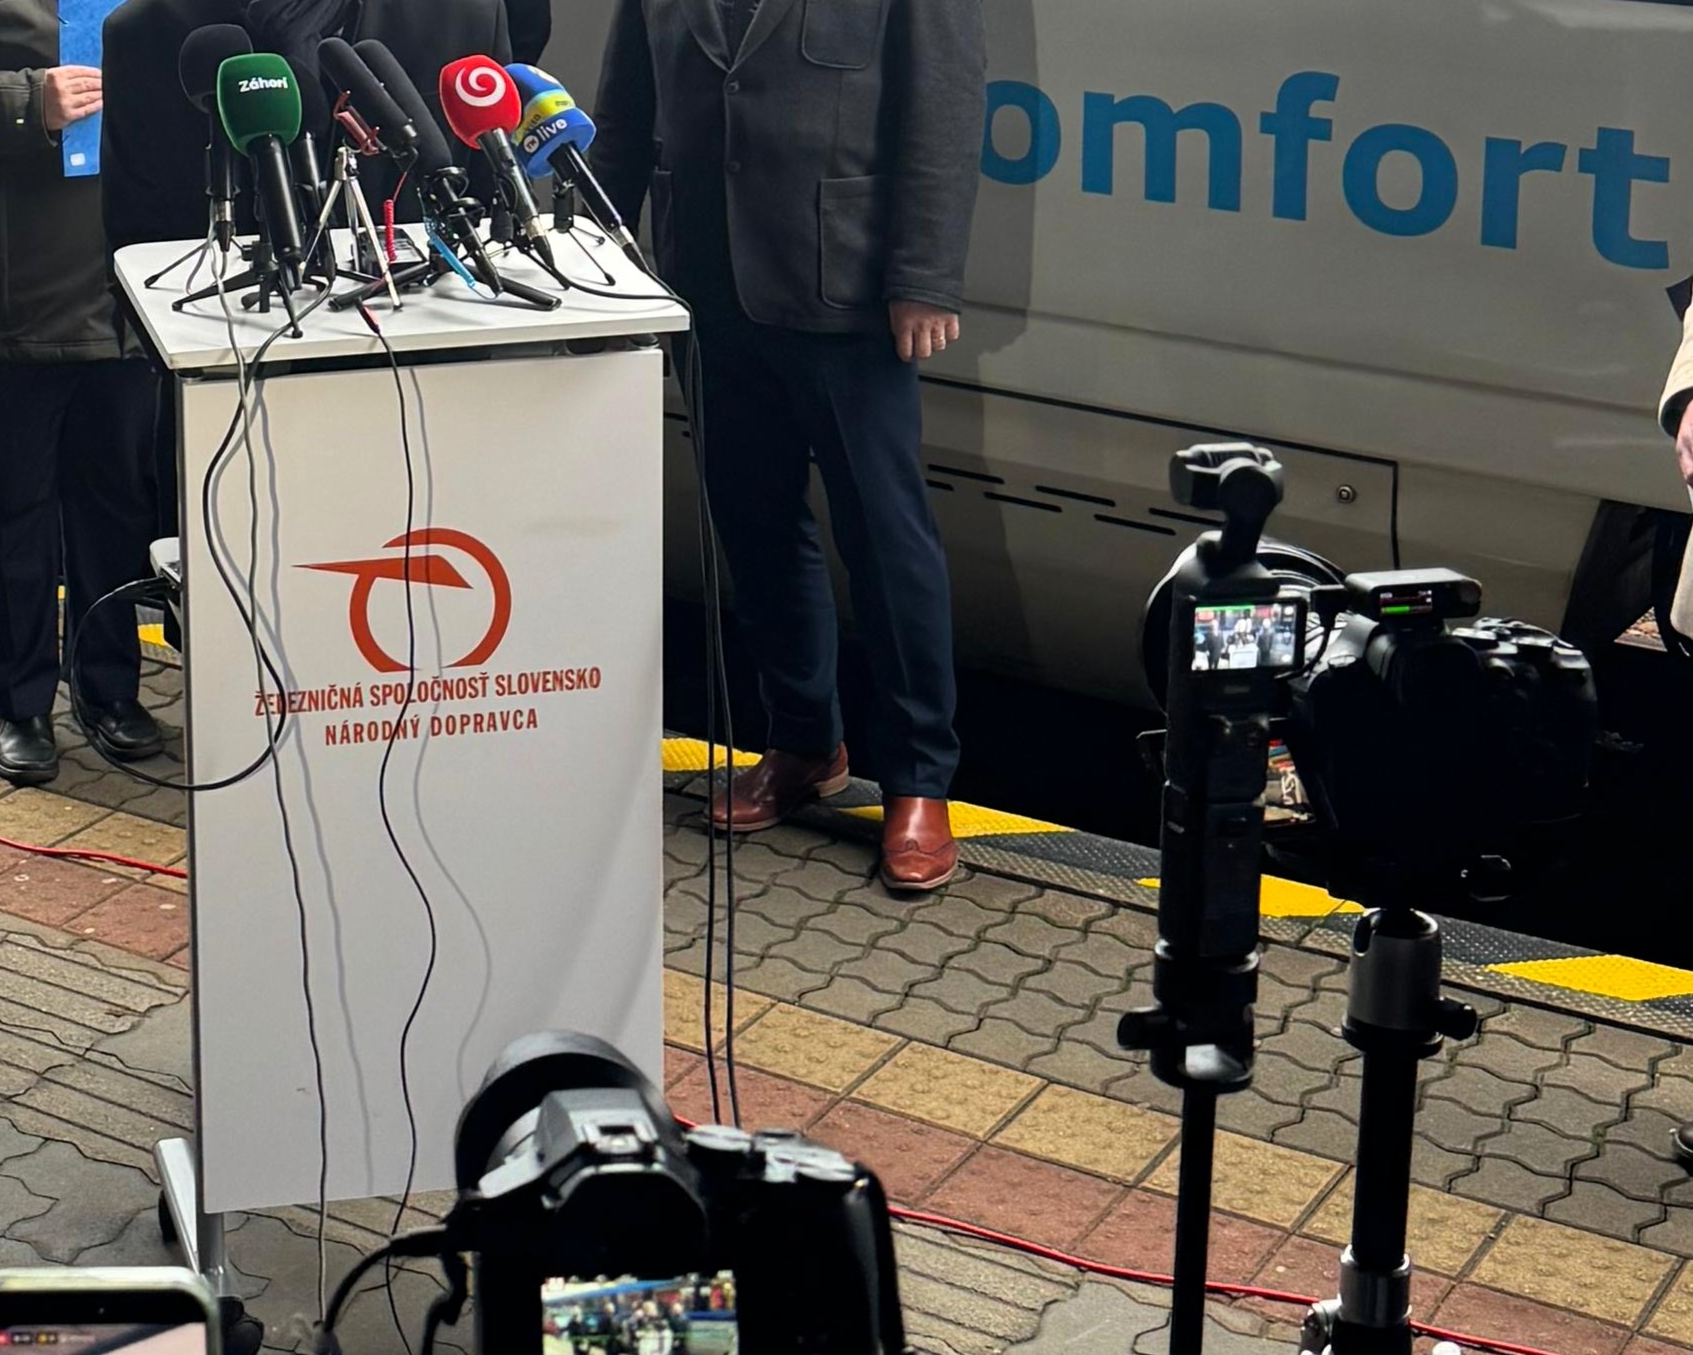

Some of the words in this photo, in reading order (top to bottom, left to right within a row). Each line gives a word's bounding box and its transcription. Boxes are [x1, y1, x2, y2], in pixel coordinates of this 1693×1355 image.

[980, 71, 1670, 269] omfort
[495, 667, 601, 696] SLOVENSKO
[326, 714, 419, 745] NÁRODNÝ
[431, 708, 538, 737] DOPRAVCA
